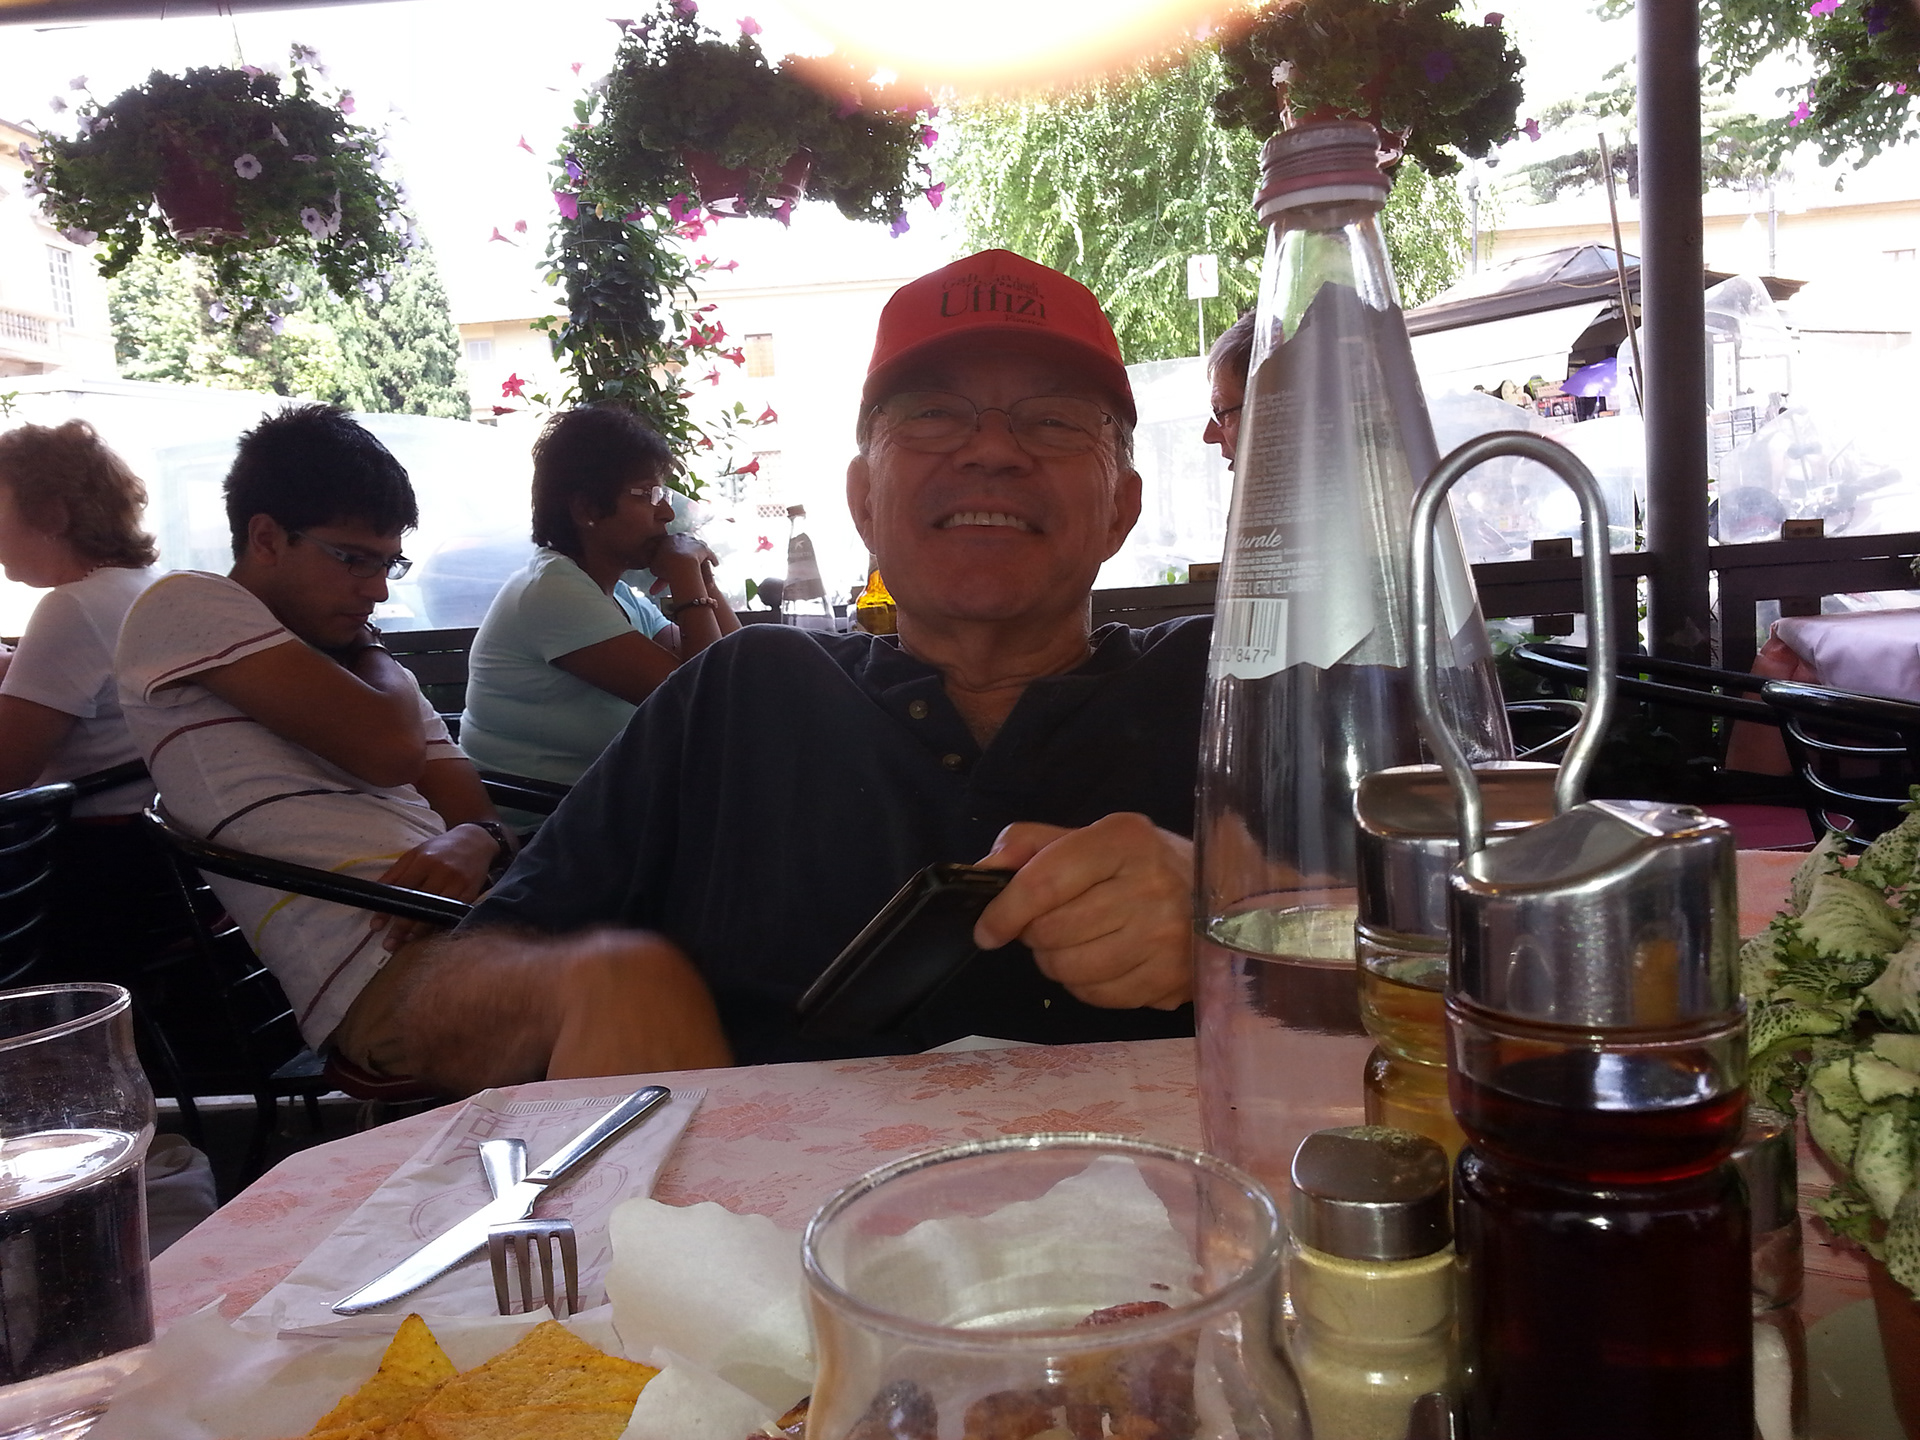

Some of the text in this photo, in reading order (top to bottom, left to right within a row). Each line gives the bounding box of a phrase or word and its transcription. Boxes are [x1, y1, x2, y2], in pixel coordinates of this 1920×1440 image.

[941, 283, 1046, 320] Uffizi
[1238, 527, 1282, 549] turale
[1236, 648, 1270, 663] 8477
